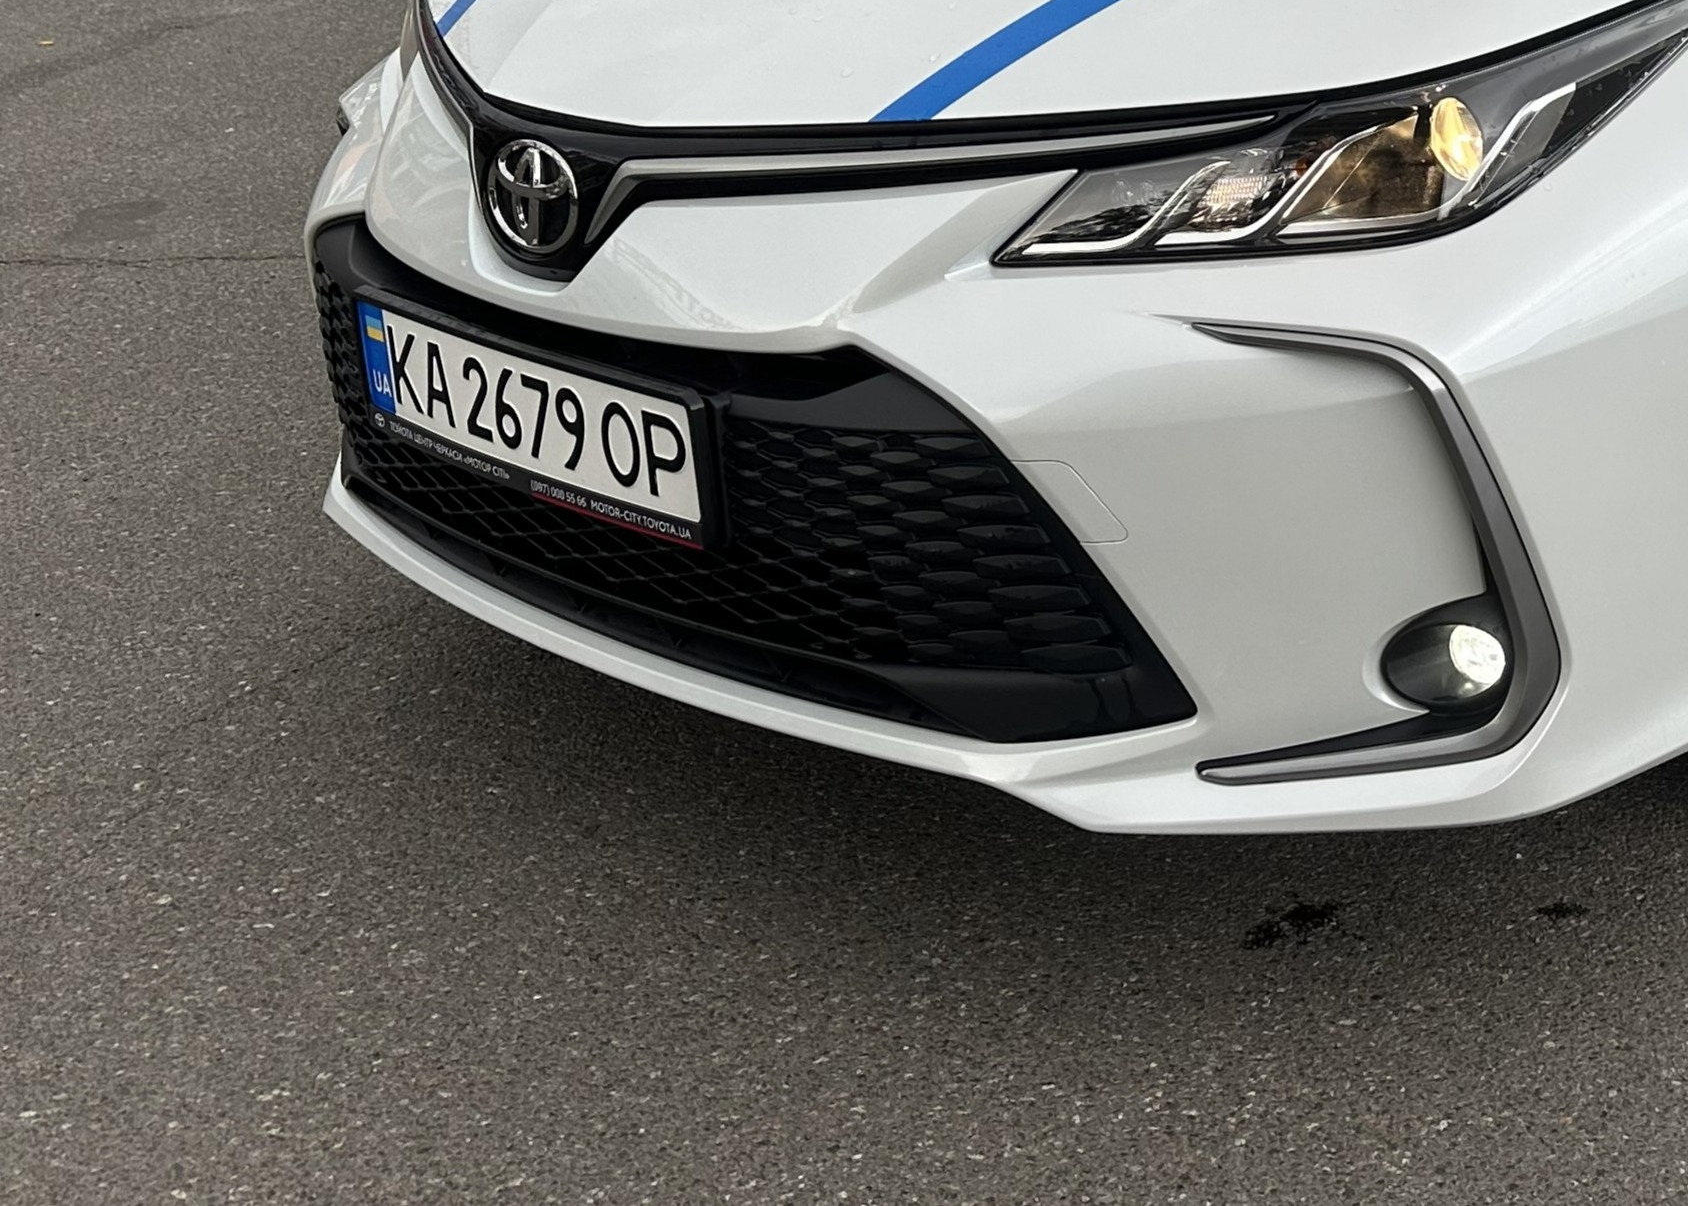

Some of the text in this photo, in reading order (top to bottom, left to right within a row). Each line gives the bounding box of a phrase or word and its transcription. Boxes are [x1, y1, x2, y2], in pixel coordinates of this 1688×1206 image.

[372, 368, 392, 397] UA
[387, 325, 687, 497] KA 2679 OP
[590, 499, 692, 540] MOTOR-CITY.TOYOTA.UA
